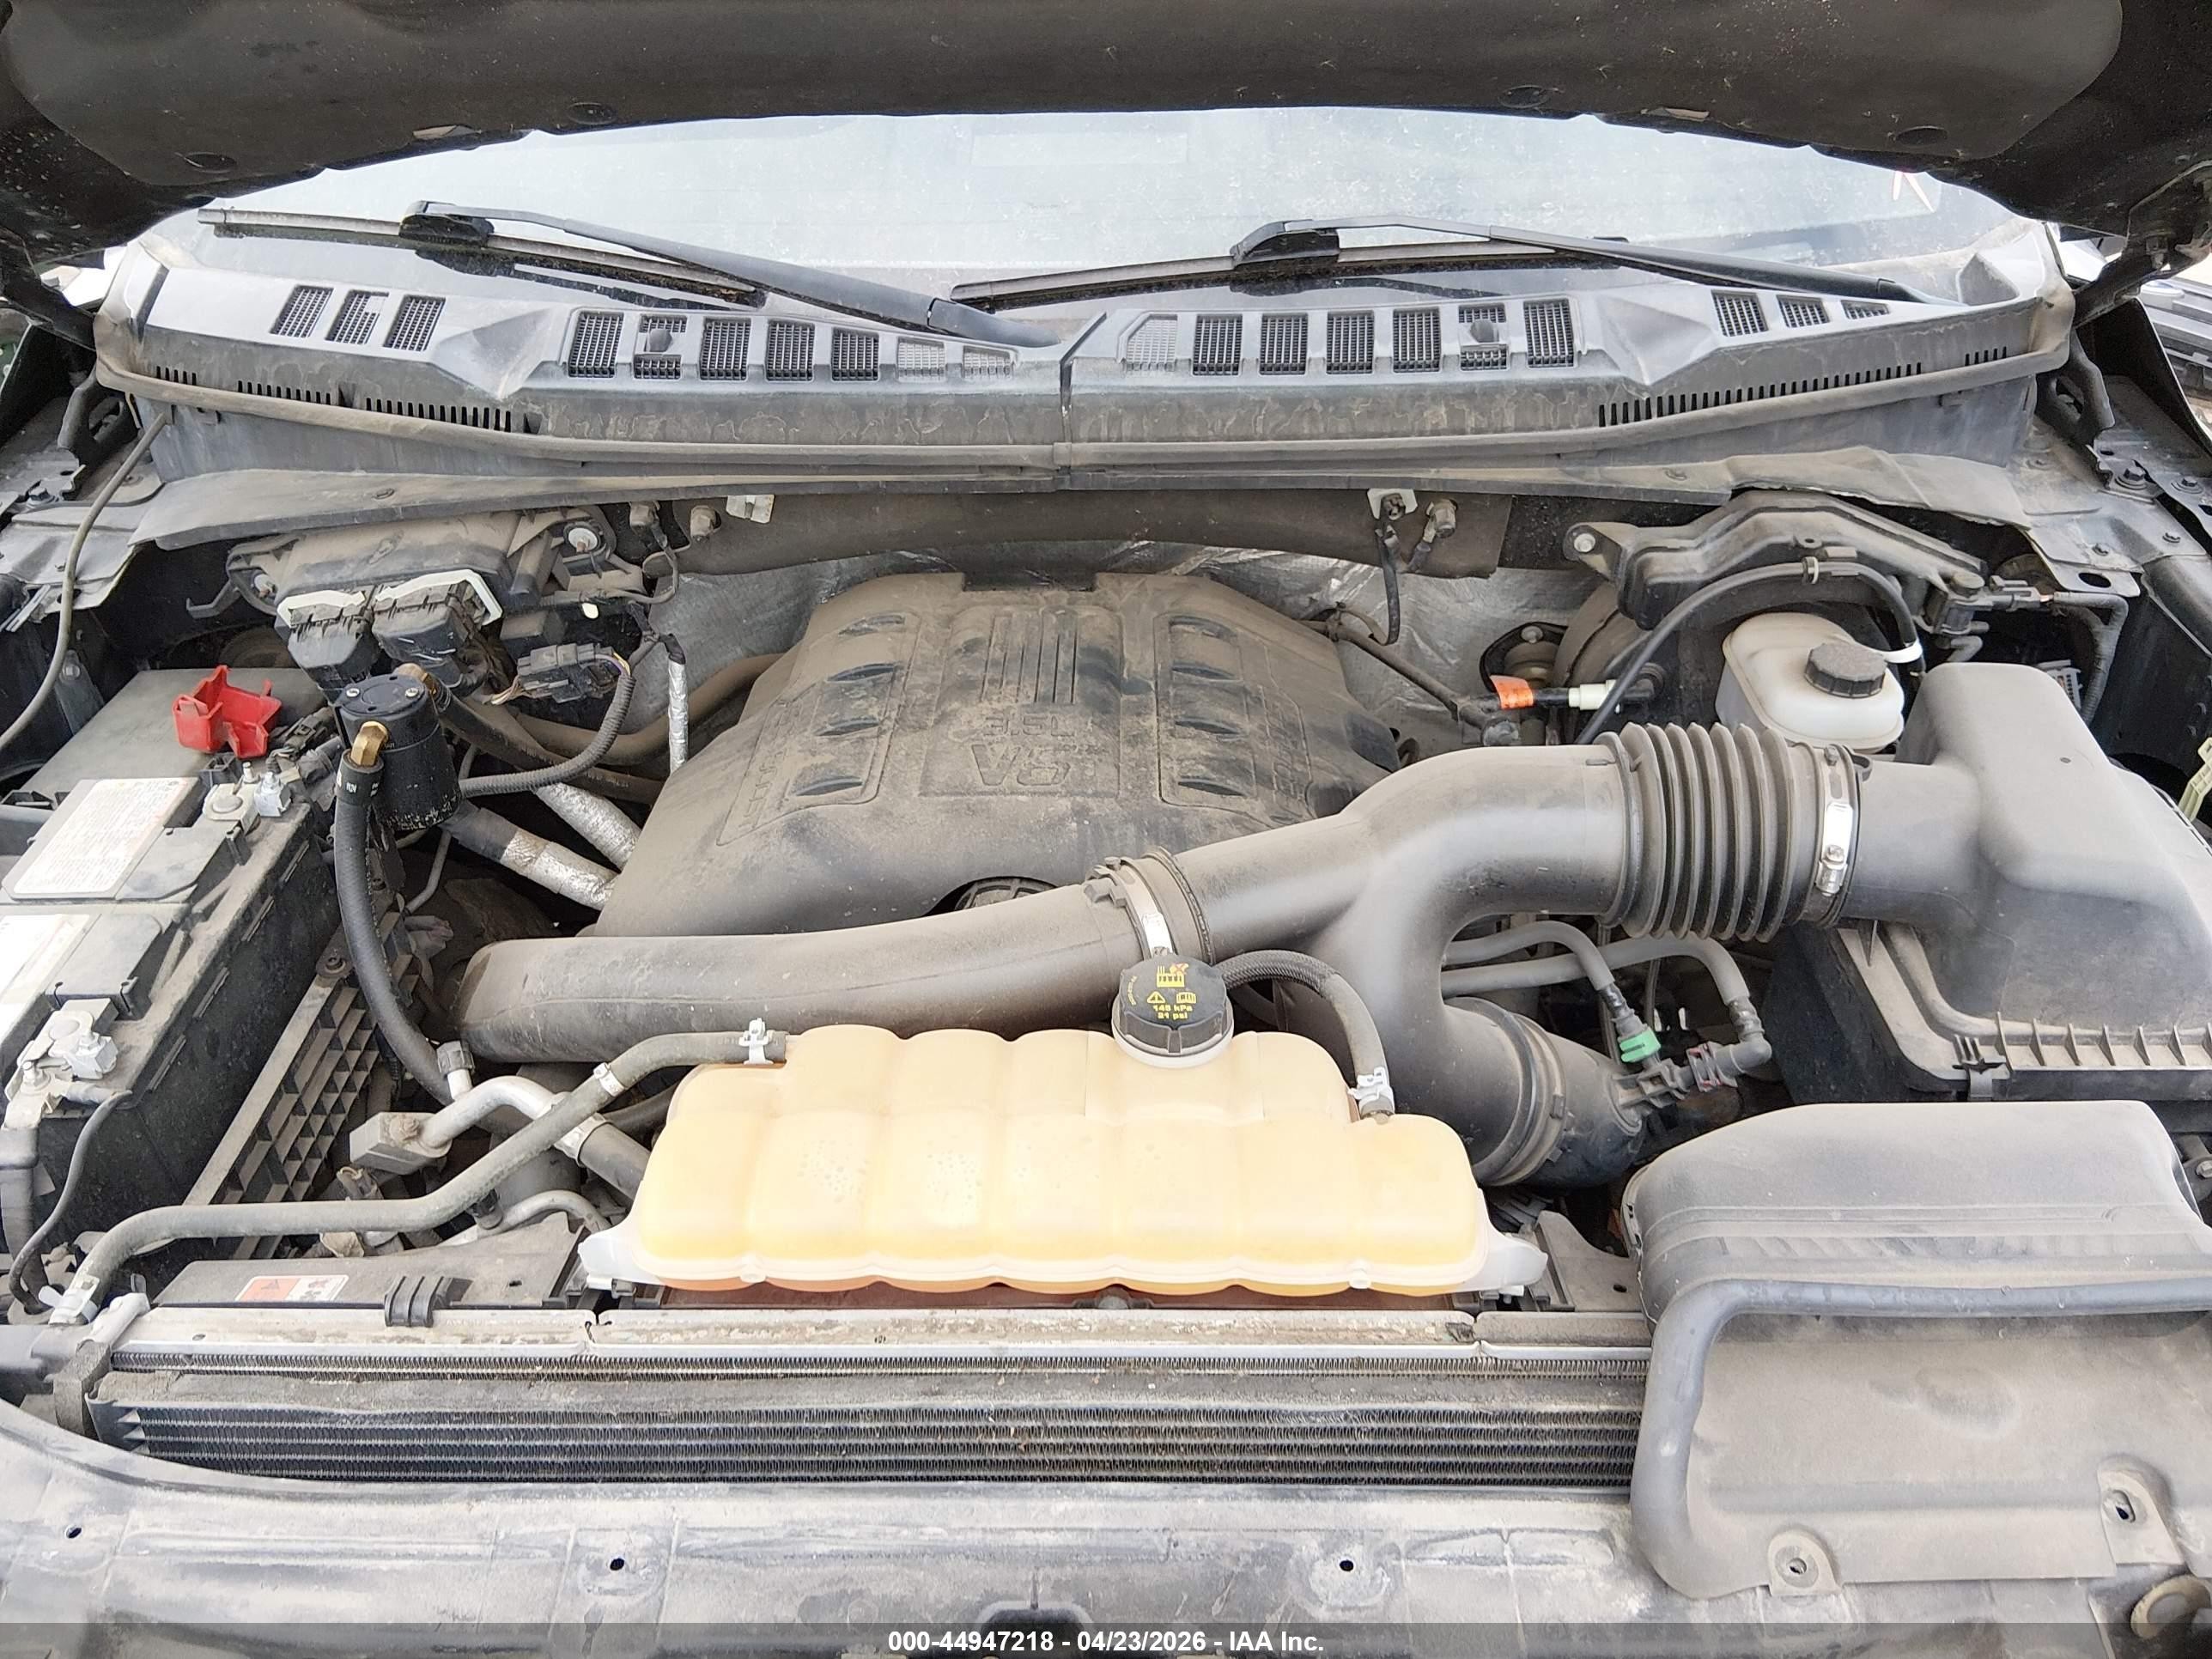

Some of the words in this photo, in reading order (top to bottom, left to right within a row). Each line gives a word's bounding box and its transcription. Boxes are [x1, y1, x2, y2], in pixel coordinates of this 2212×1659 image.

[982, 715, 1075, 737] 3.5L
[970, 744, 1072, 787] V6
[1172, 1012, 1188, 1020] psi
